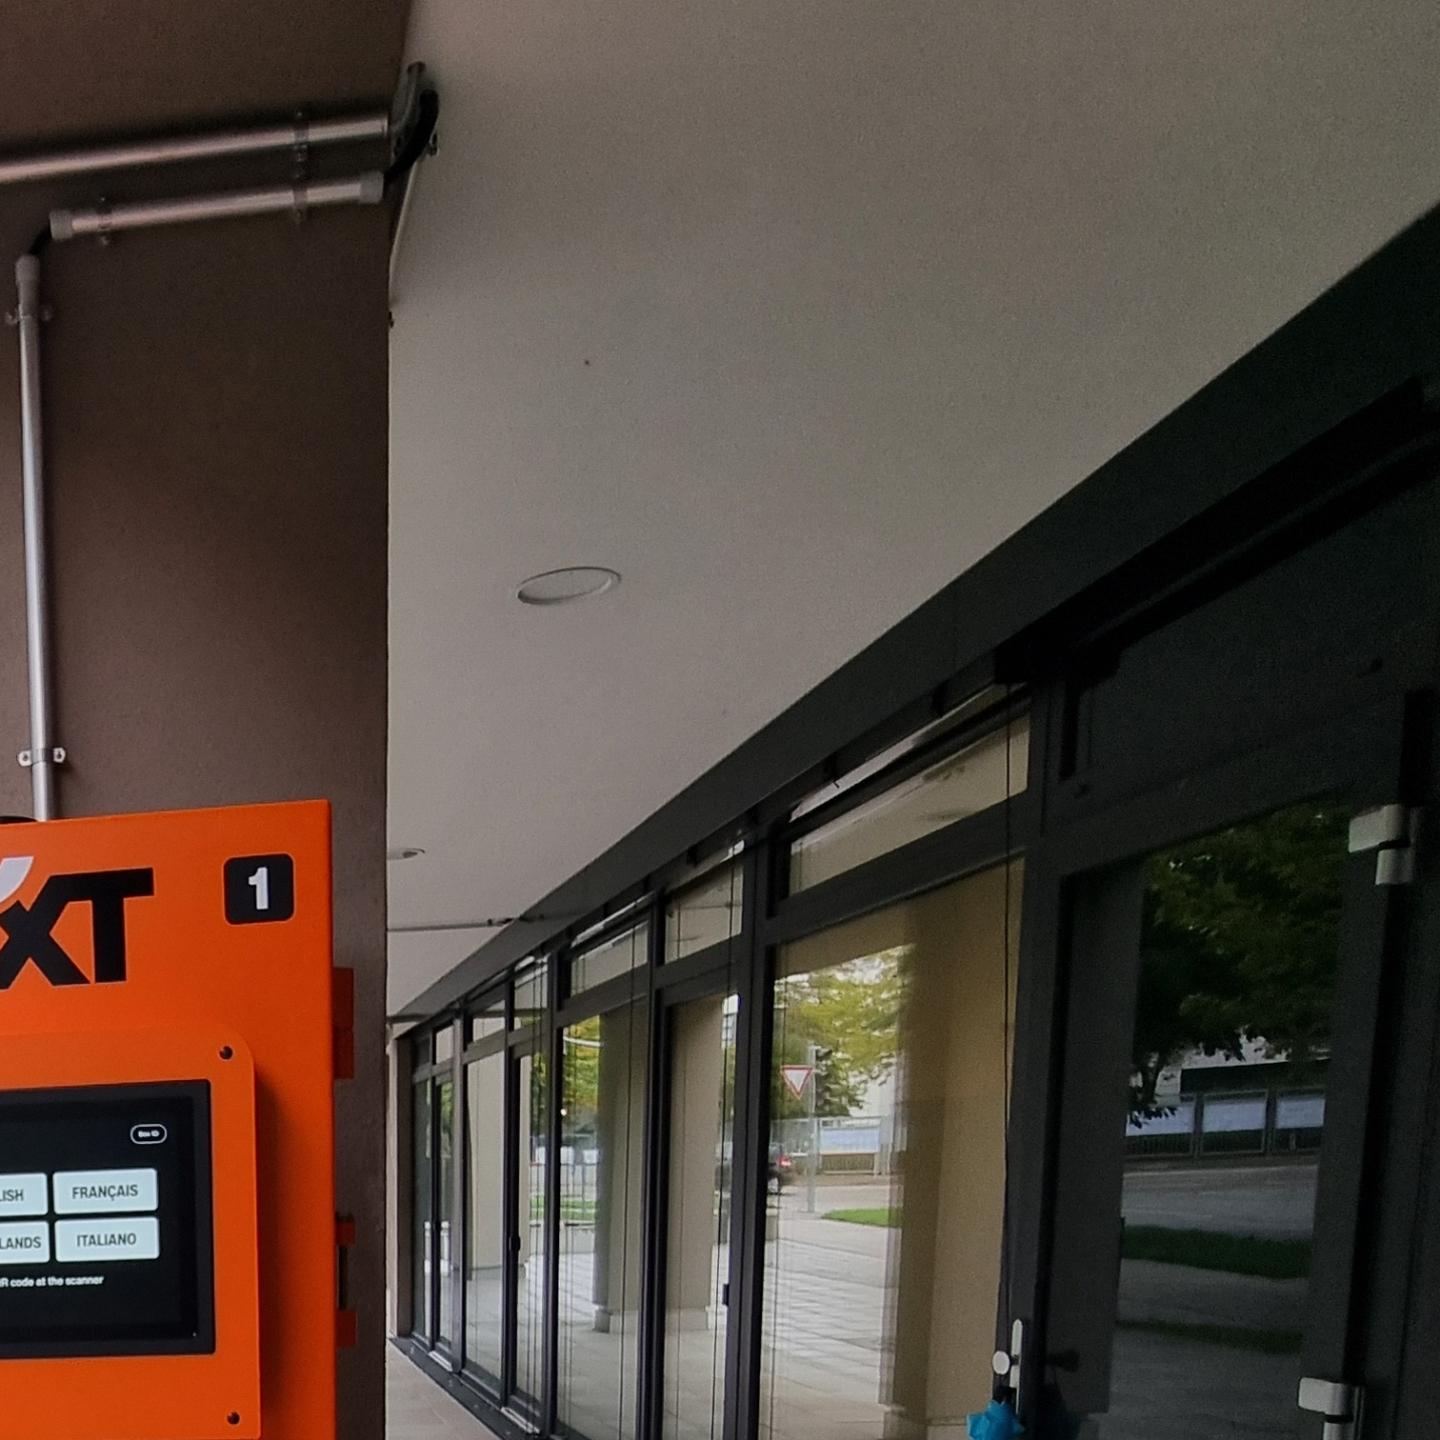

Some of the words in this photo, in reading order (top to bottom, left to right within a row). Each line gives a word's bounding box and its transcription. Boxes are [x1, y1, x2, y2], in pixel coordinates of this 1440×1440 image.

[248, 867, 269, 910] 1
[71, 1184, 139, 1200] FRANÇAIS
[76, 1233, 137, 1248] ITALIANO
[10, 1277, 34, 1288] code
[36, 1277, 46, 1287] at
[47, 1276, 63, 1286] the
[65, 1275, 104, 1286] scanner
